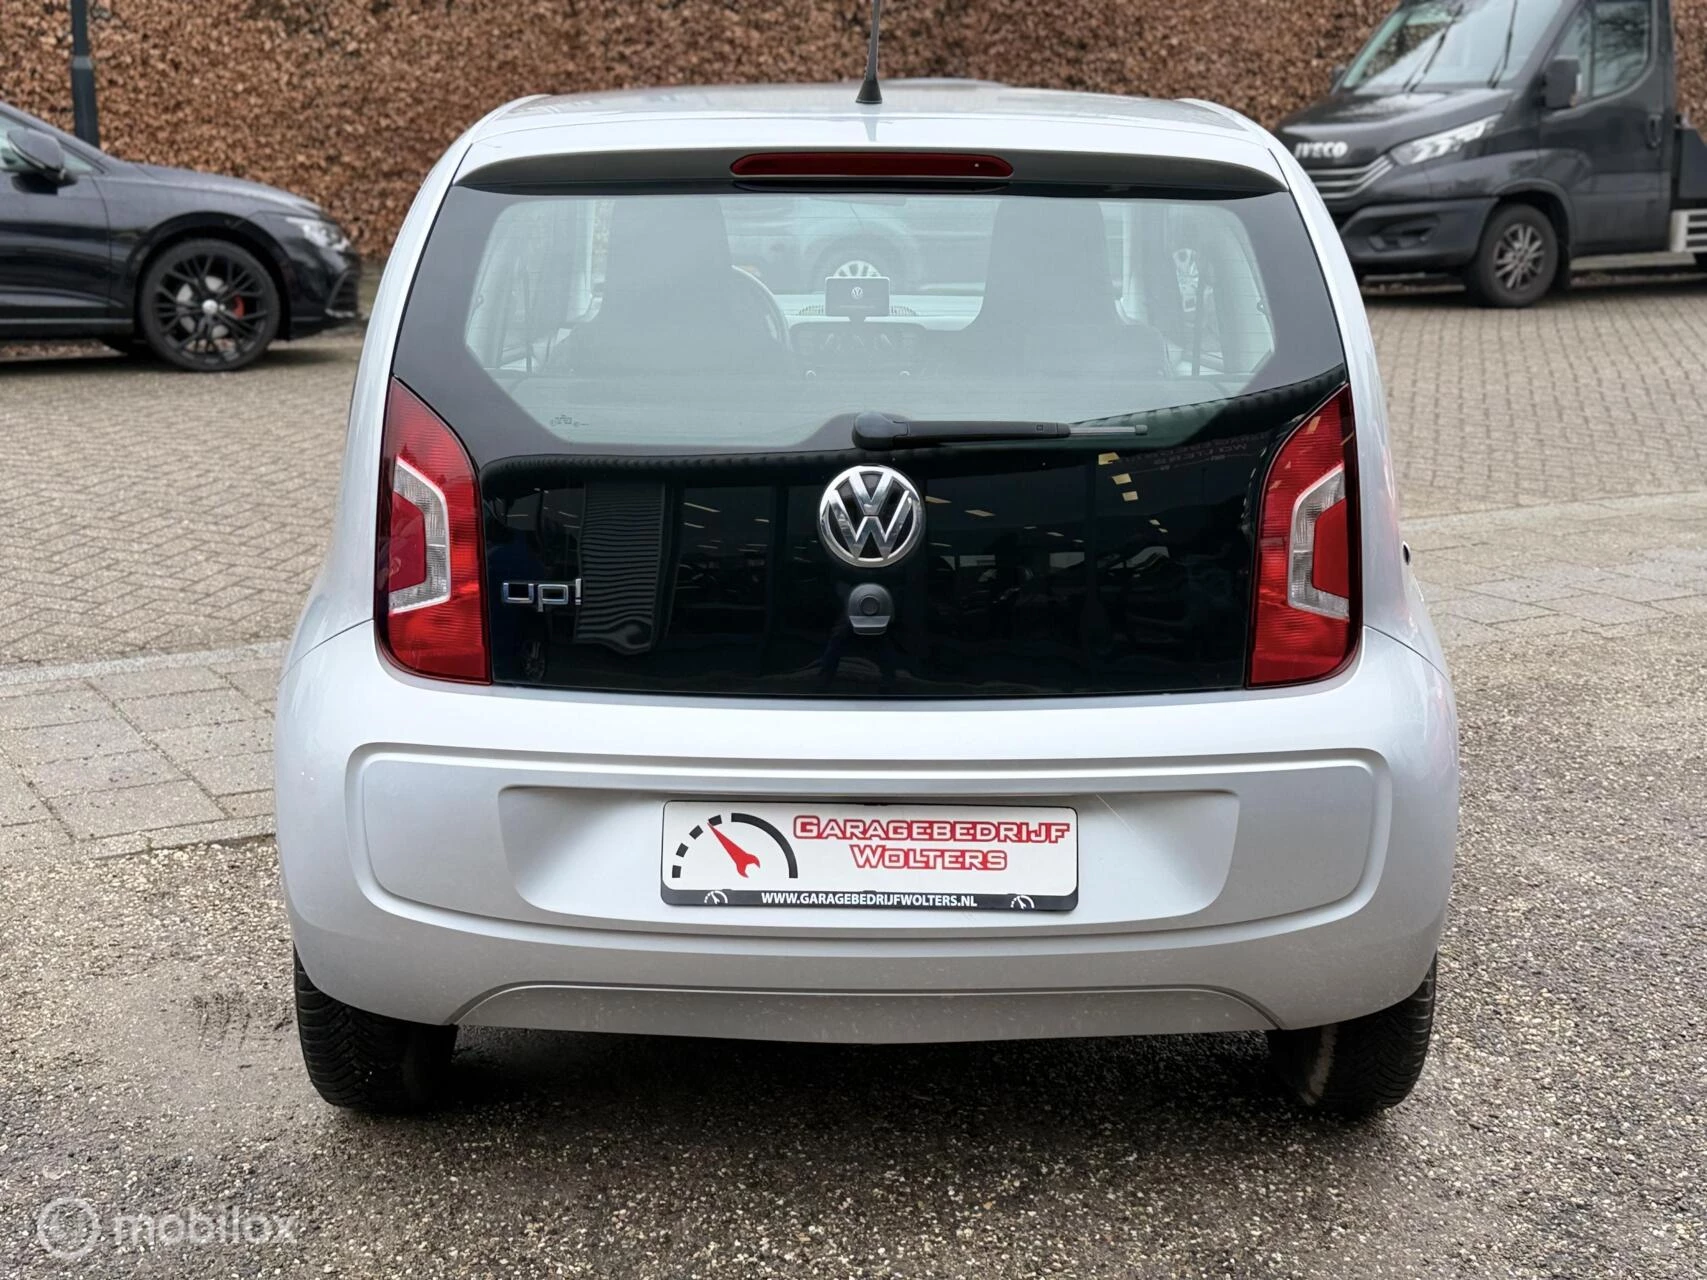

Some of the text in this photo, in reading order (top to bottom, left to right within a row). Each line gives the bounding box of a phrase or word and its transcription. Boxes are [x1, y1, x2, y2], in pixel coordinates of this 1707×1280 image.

[1295, 142, 1348, 158] IVECO
[503, 578, 581, 612] up!
[793, 816, 1070, 843] GARAGEBEDRIJF
[850, 845, 1007, 870] WOLTERS
[761, 892, 978, 908] WWW.GARAGEBEDRIJFWOLTERS.NL
